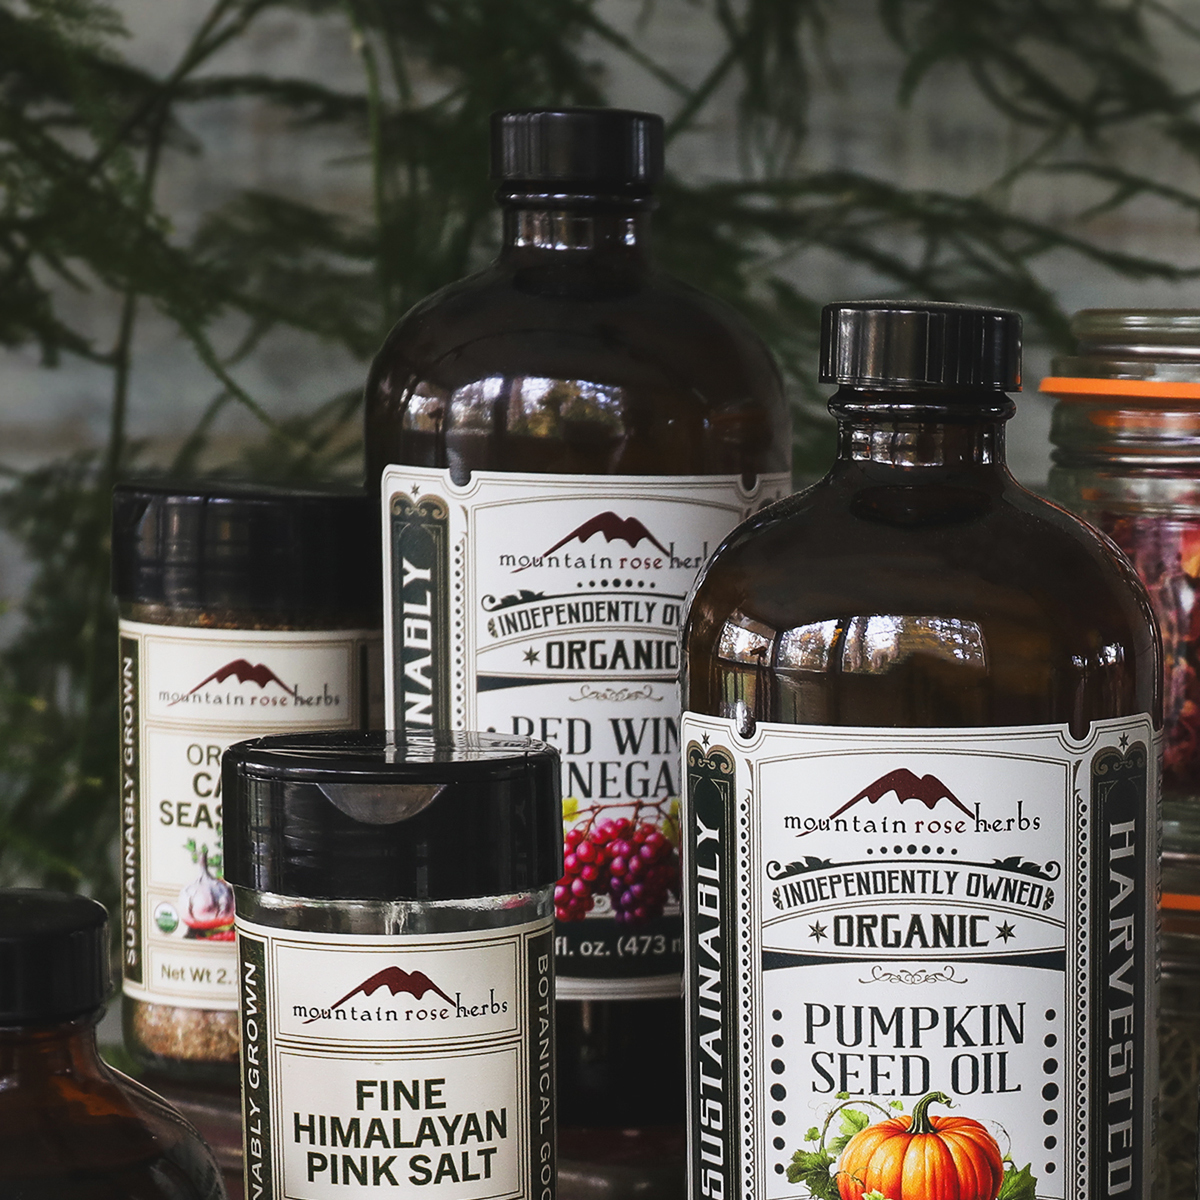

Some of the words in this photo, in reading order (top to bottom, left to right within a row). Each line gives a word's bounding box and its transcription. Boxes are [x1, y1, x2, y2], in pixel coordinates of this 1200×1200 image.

[499, 552, 612, 570] mountain
[619, 556, 663, 570] rose
[668, 542, 708, 569] her
[499, 601, 655, 636] INDEPENDENTLY
[546, 640, 678, 670] ORGANIC
[122, 656, 134, 766] GROWN
[159, 688, 244, 706] mountain
[251, 693, 288, 706] rose
[294, 684, 340, 706] herbs
[608, 718, 678, 755] WIN
[561, 760, 677, 799] NEGA
[784, 812, 906, 834] mountain
[915, 818, 966, 834] rose
[974, 800, 1040, 834] herbs
[123, 769, 137, 966] SUSTAINABLY
[782, 870, 957, 909] INDEPENDENTLY
[966, 873, 1046, 910] OWNED
[580, 941, 610, 956] oz.
[617, 935, 665, 956] (473
[833, 914, 990, 948] ORGANIC
[161, 964, 185, 980] Net
[190, 966, 211, 982] Wt
[217, 969, 238, 984] 2.
[293, 1003, 398, 1021] mountain
[405, 1008, 449, 1021] rose
[455, 988, 508, 1018] herbs
[1107, 818, 1137, 1196] HARVESTED
[243, 961, 260, 1089] GROWN
[804, 1002, 1026, 1048] PUMPKIN
[537, 953, 551, 1135] BOTANICAL
[811, 1051, 930, 1096] SEED
[950, 1051, 1022, 1095] OIL
[356, 1078, 446, 1111] FINE
[294, 1108, 507, 1149] HIMALAYAN
[307, 1151, 399, 1186] PINK
[408, 1148, 498, 1186] SALT
